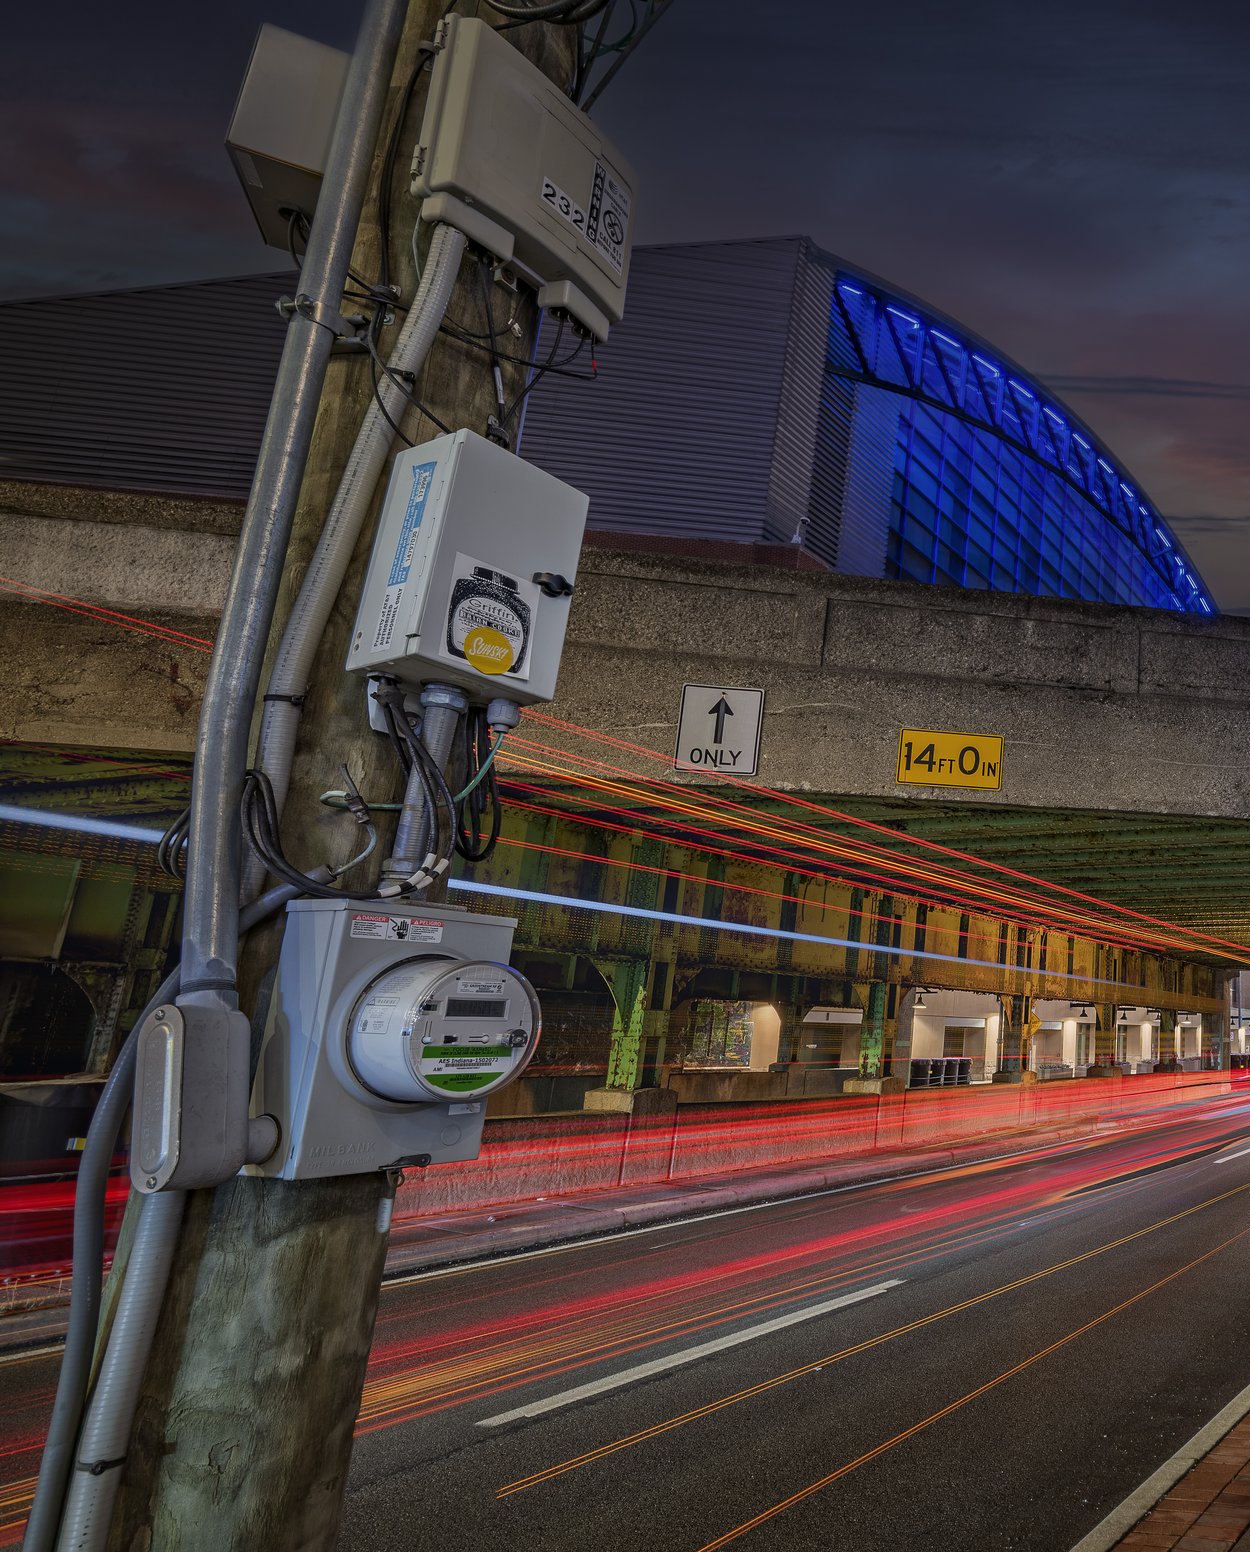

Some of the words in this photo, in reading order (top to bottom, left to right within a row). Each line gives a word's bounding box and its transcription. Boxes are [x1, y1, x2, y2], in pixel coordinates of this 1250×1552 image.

[543, 183, 585, 231] 232
[586, 163, 606, 243] WARNING
[600, 231, 612, 248] CALL
[379, 604, 393, 646] AUTHORIZED
[385, 606, 398, 645] PERSONNEL
[395, 588, 403, 606] ONLY
[690, 747, 743, 767] ONLY
[310, 1142, 376, 1159] MILBANK
